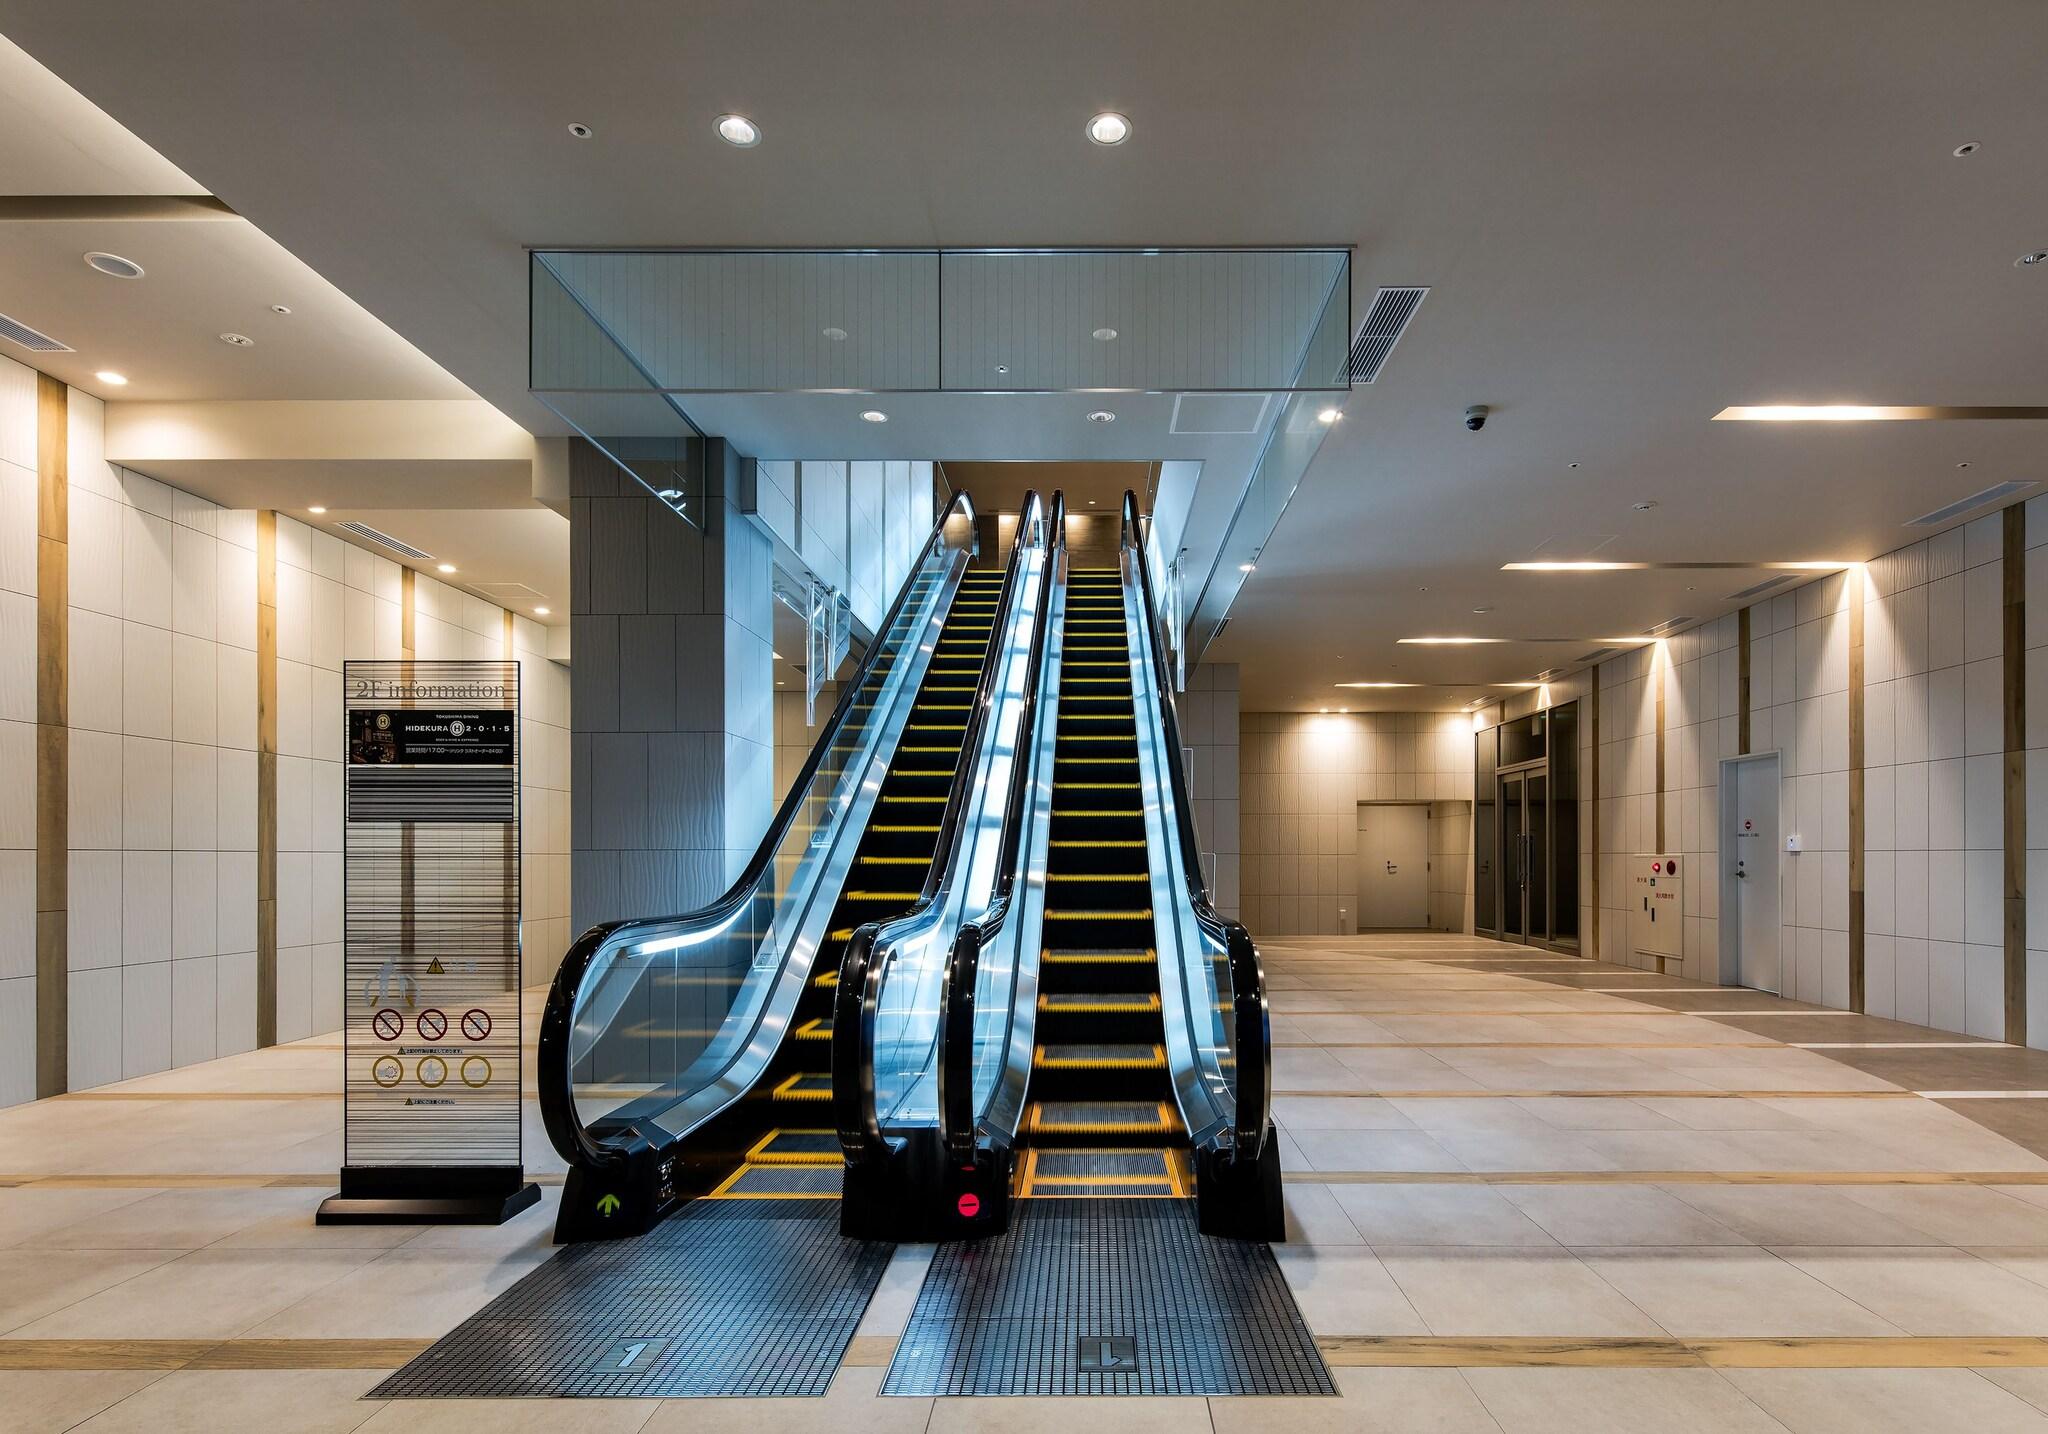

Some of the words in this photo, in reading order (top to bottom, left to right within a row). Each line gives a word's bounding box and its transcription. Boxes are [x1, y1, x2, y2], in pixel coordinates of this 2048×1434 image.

[357, 680, 382, 698] 2F
[388, 680, 505, 698] information
[616, 1343, 649, 1367] 1
